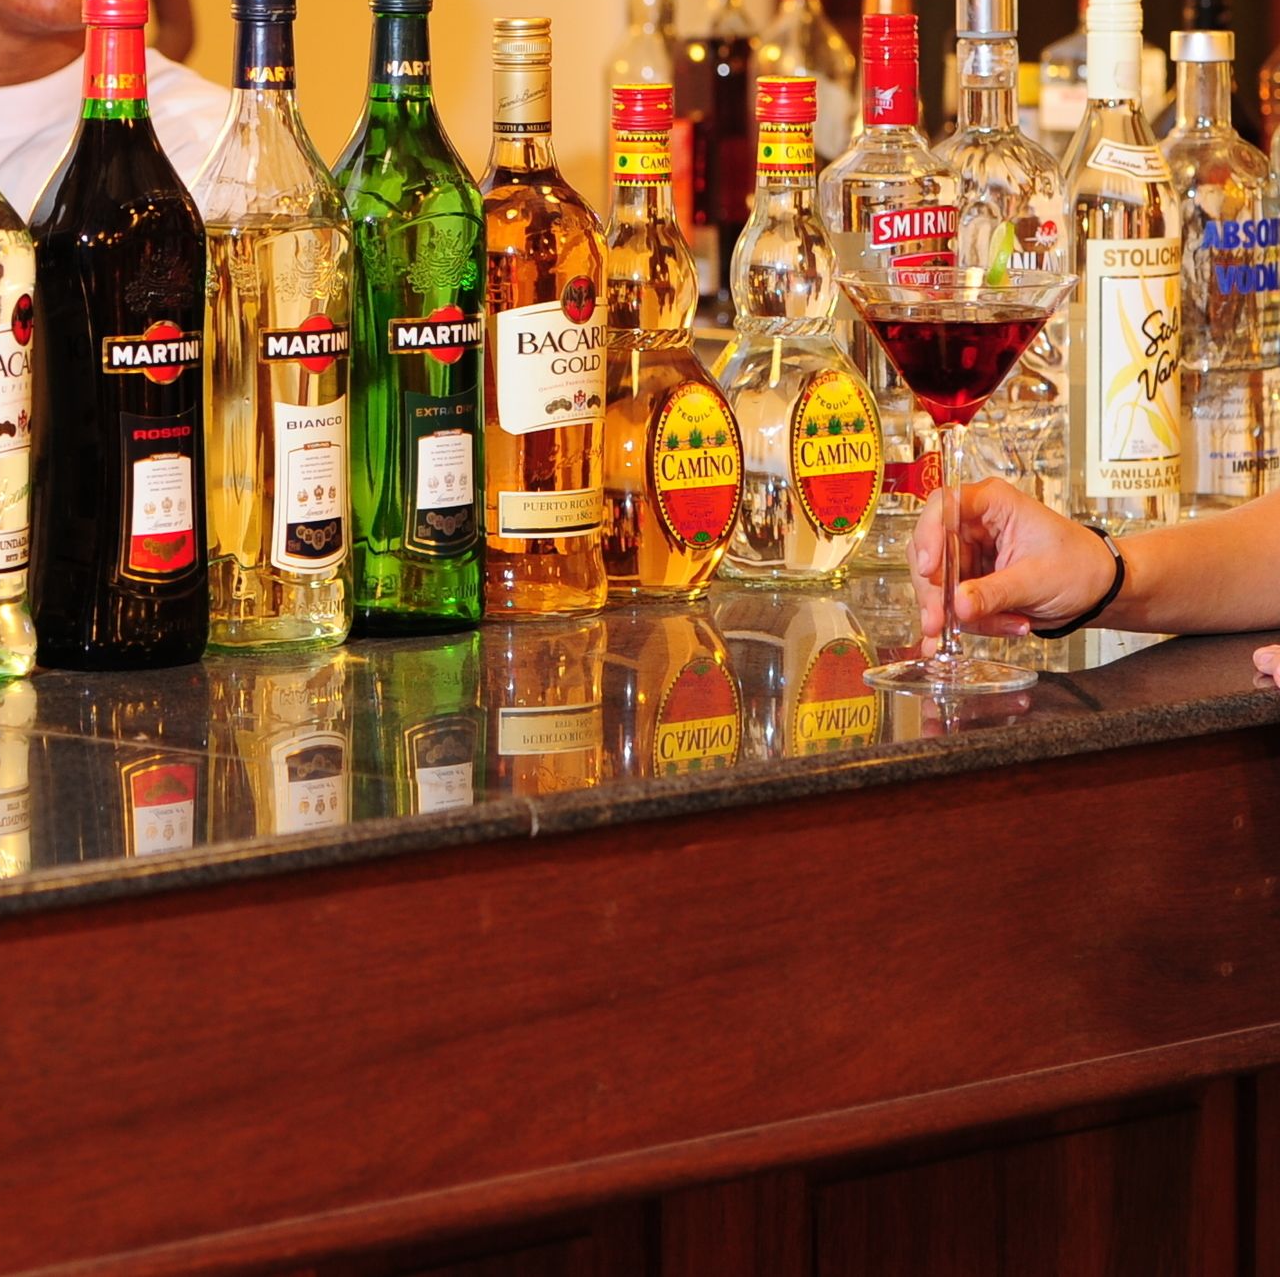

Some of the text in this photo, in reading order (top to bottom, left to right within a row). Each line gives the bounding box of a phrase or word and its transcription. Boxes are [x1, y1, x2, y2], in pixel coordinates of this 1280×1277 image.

[398, 321, 481, 348] MARTINI
[268, 331, 348, 357] MARTINI
[112, 339, 199, 366] MARTINI
[551, 355, 601, 375] GOLD
[415, 406, 454, 418] EXTRA
[677, 405, 716, 423] TEQUILA
[286, 416, 342, 430] BIANCO
[132, 426, 191, 440] ROSSO
[801, 437, 871, 468] CAMINO
[661, 451, 733, 481] CAMINO
[1100, 467, 1161, 480] VANILLA
[1111, 477, 1171, 491] RUSSIAN
[523, 499, 568, 512] PUERTO
[576, 510, 594, 523] 1862
